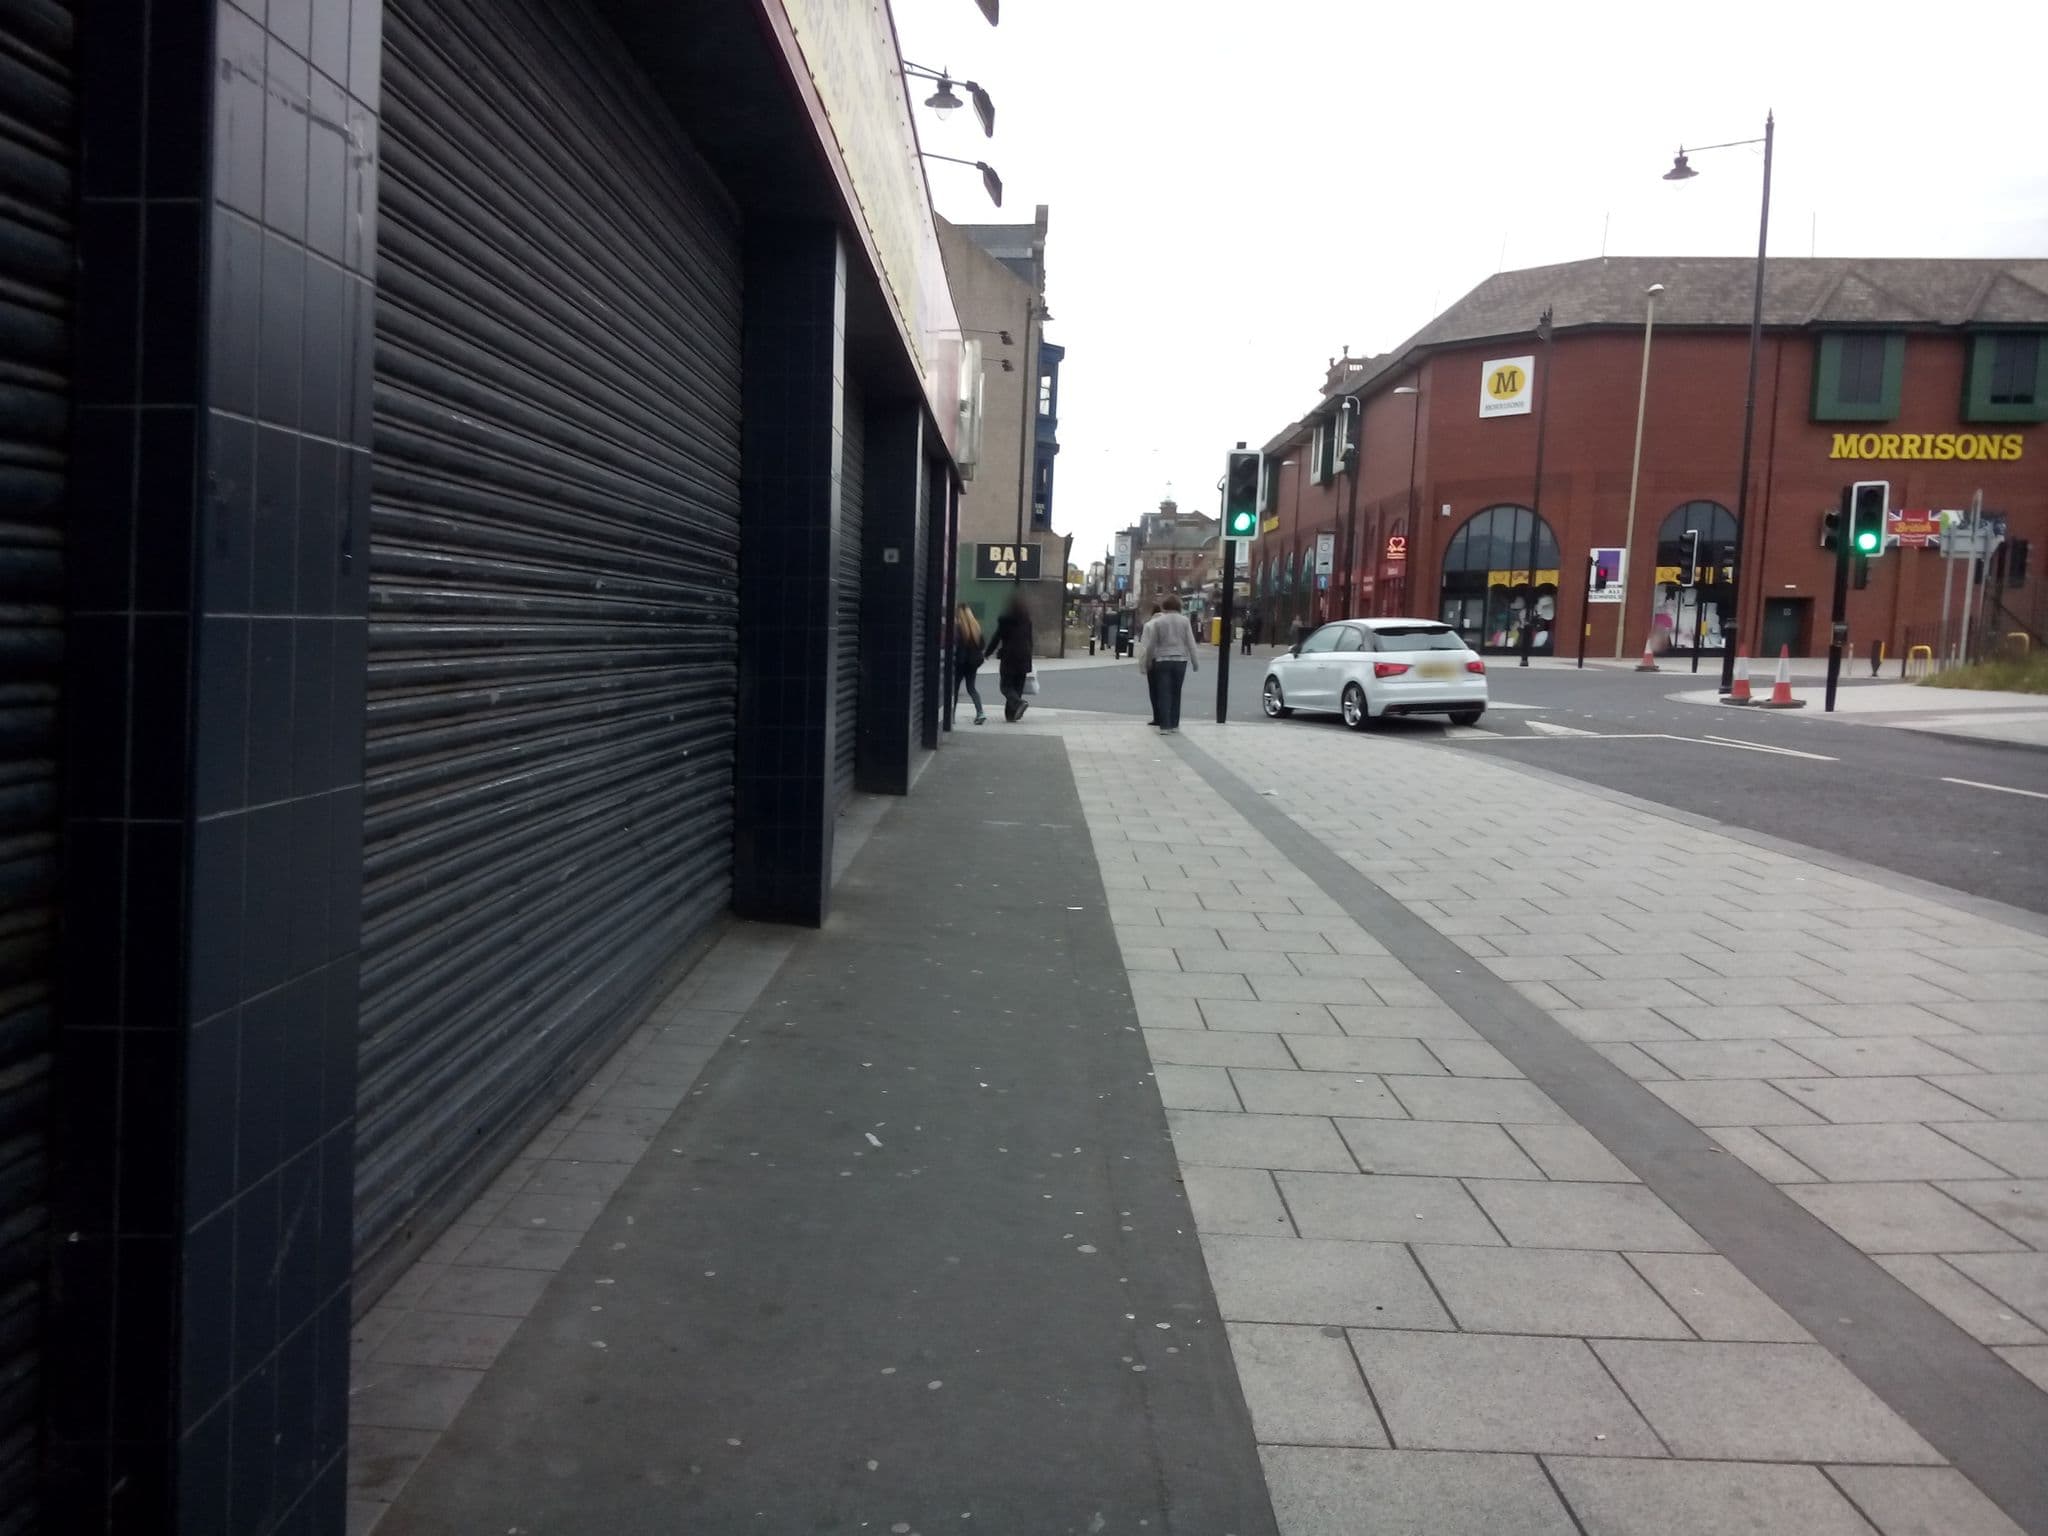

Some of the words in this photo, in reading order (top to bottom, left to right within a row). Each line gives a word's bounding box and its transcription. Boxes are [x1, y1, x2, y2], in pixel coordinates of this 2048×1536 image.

[1494, 370, 1518, 394] M
[1829, 433, 2024, 460] MORRISONS
[994, 561, 1017, 576] 44
